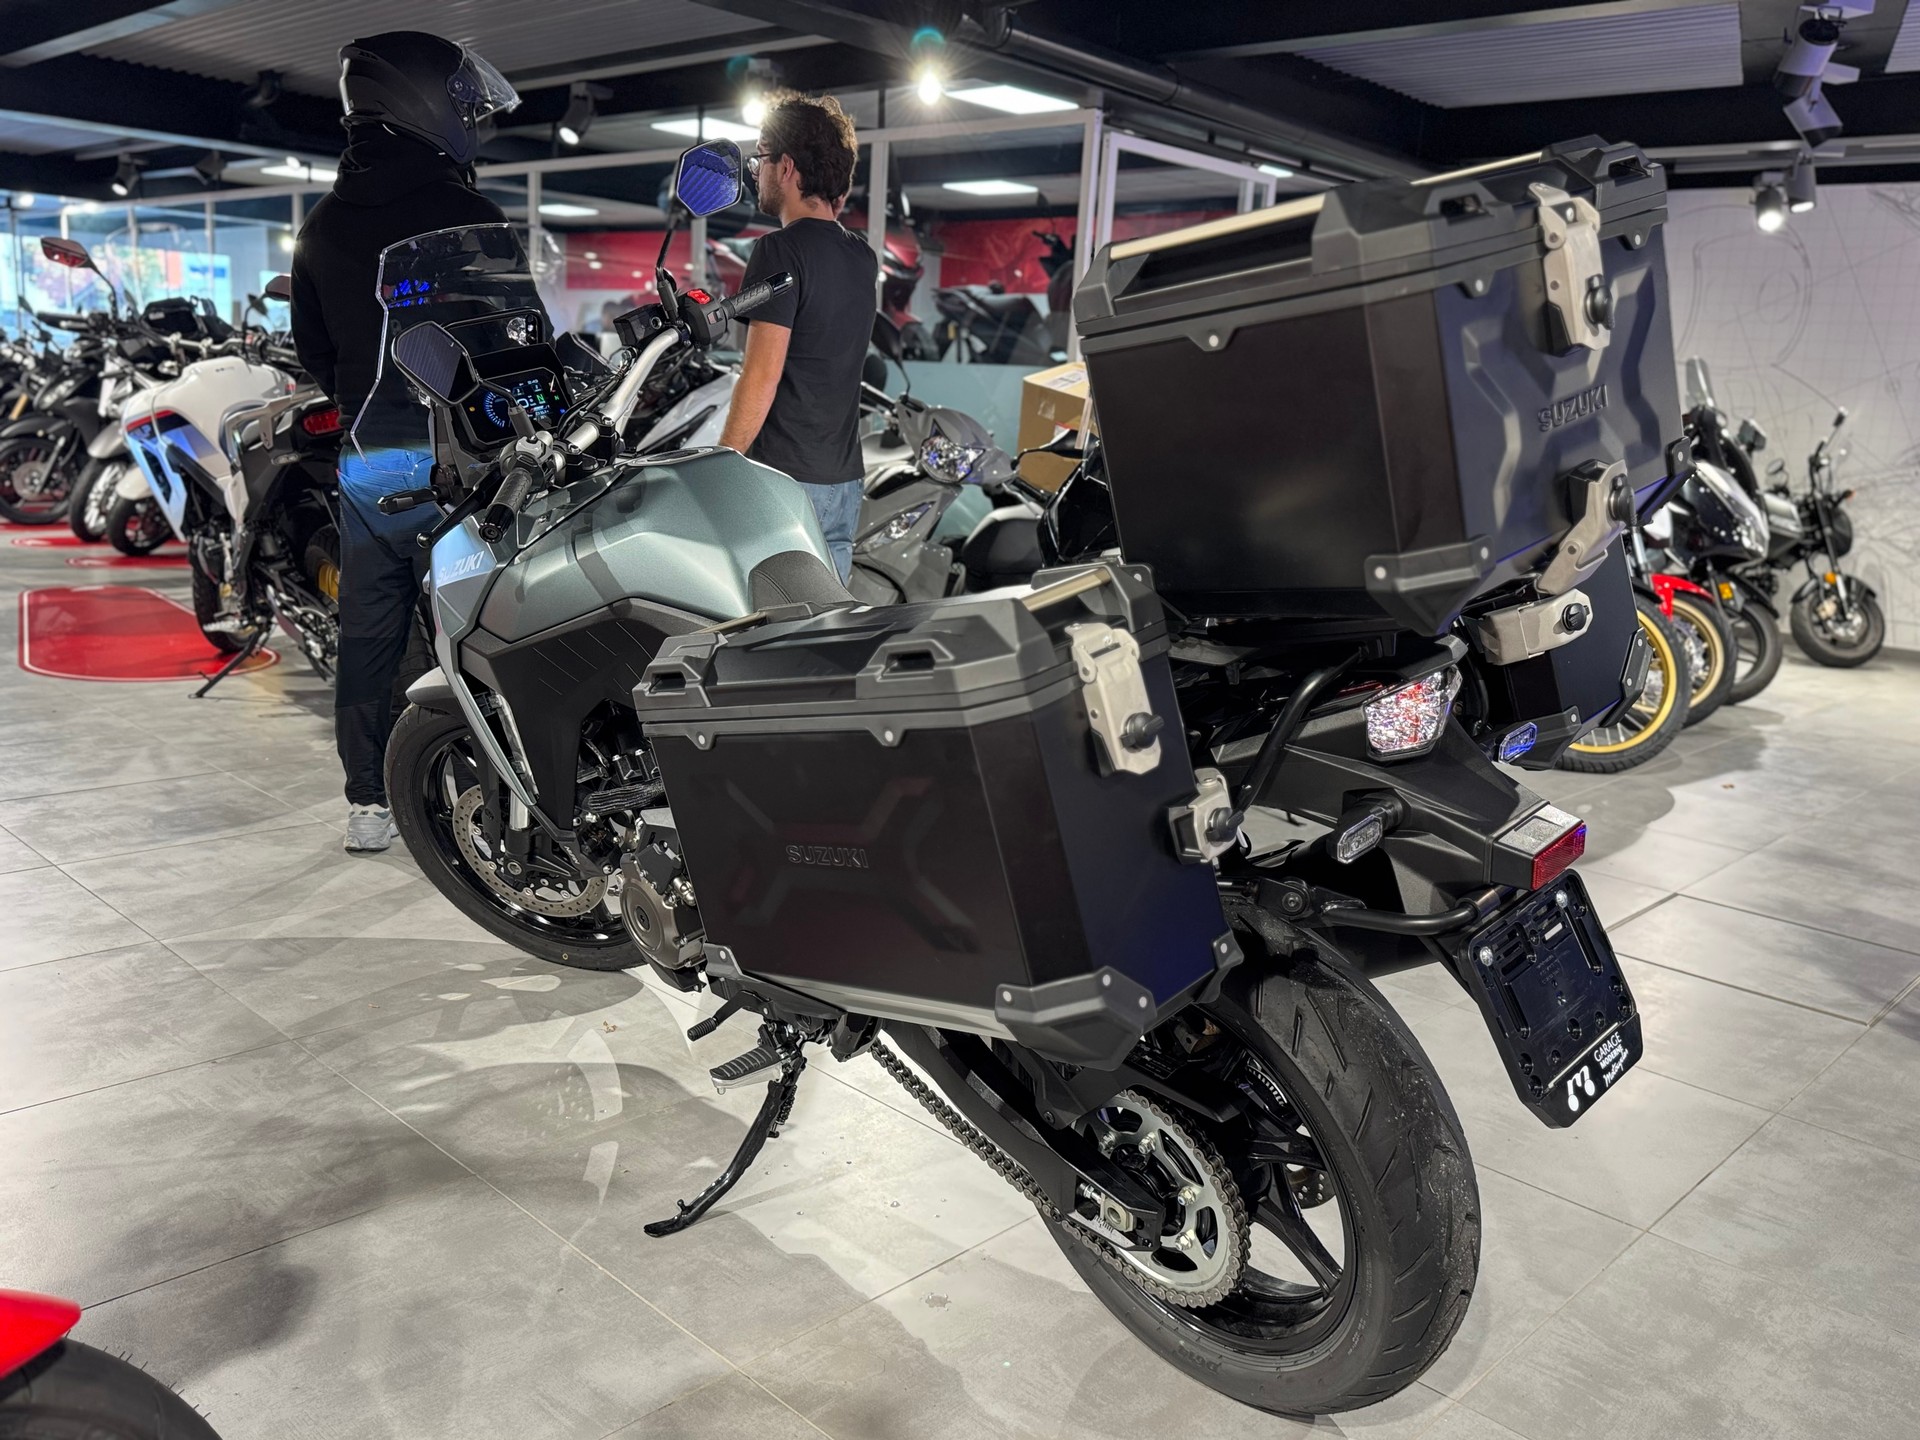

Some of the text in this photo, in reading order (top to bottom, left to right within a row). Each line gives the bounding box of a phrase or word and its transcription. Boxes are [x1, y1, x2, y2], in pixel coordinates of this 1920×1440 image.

[1537, 383, 1609, 433] SUZUKI
[438, 550, 485, 581] SUZUKI
[785, 844, 869, 869] SUZUKI
[1593, 1031, 1622, 1062] GARAGE
[1600, 1044, 1625, 1070] MODERNE
